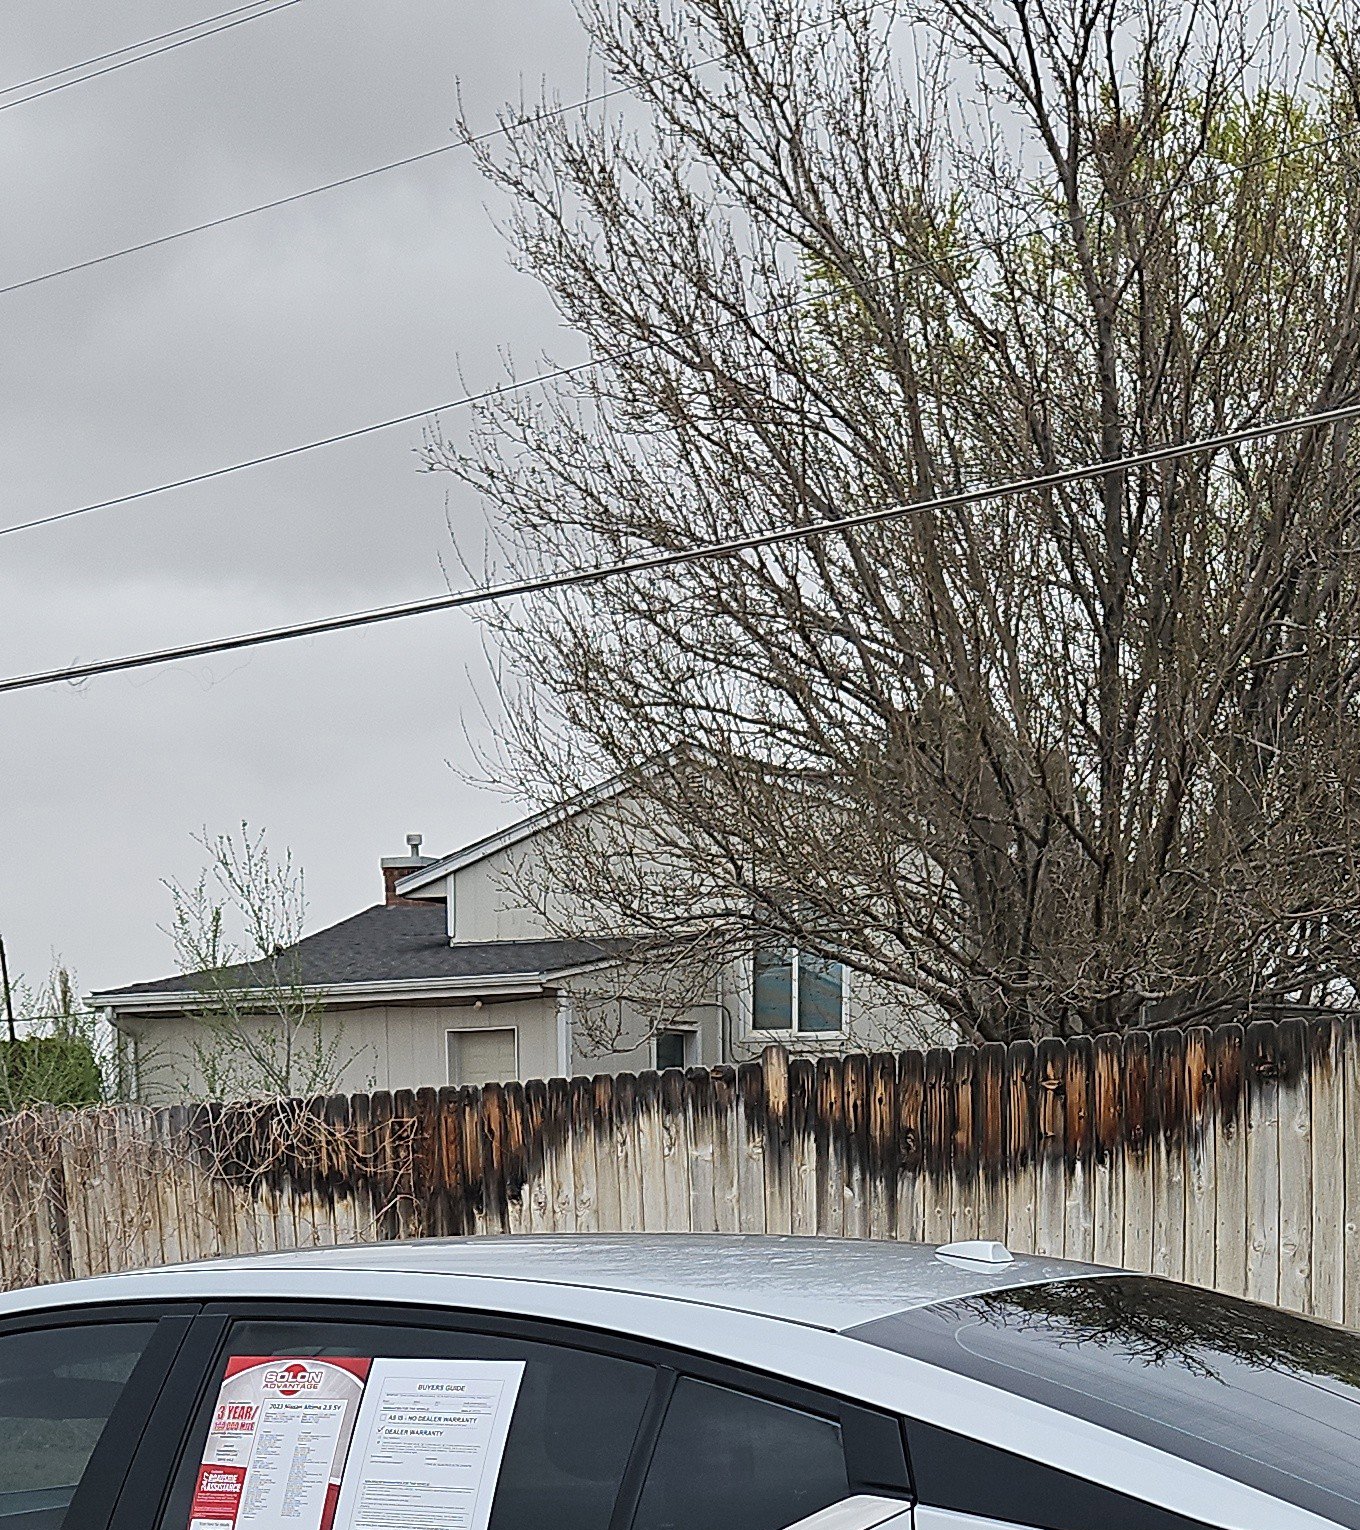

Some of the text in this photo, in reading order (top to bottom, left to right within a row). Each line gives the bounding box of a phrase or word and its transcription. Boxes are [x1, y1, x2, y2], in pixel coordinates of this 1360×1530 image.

[264, 1371, 324, 1384] SOLON
[217, 1405, 226, 1420] 3
[227, 1405, 260, 1421] YEAR/
[418, 1415, 443, 1423] DEALER
[443, 1416, 478, 1424] WARRANTY
[384, 1428, 444, 1437] DEALER WARRANTY
